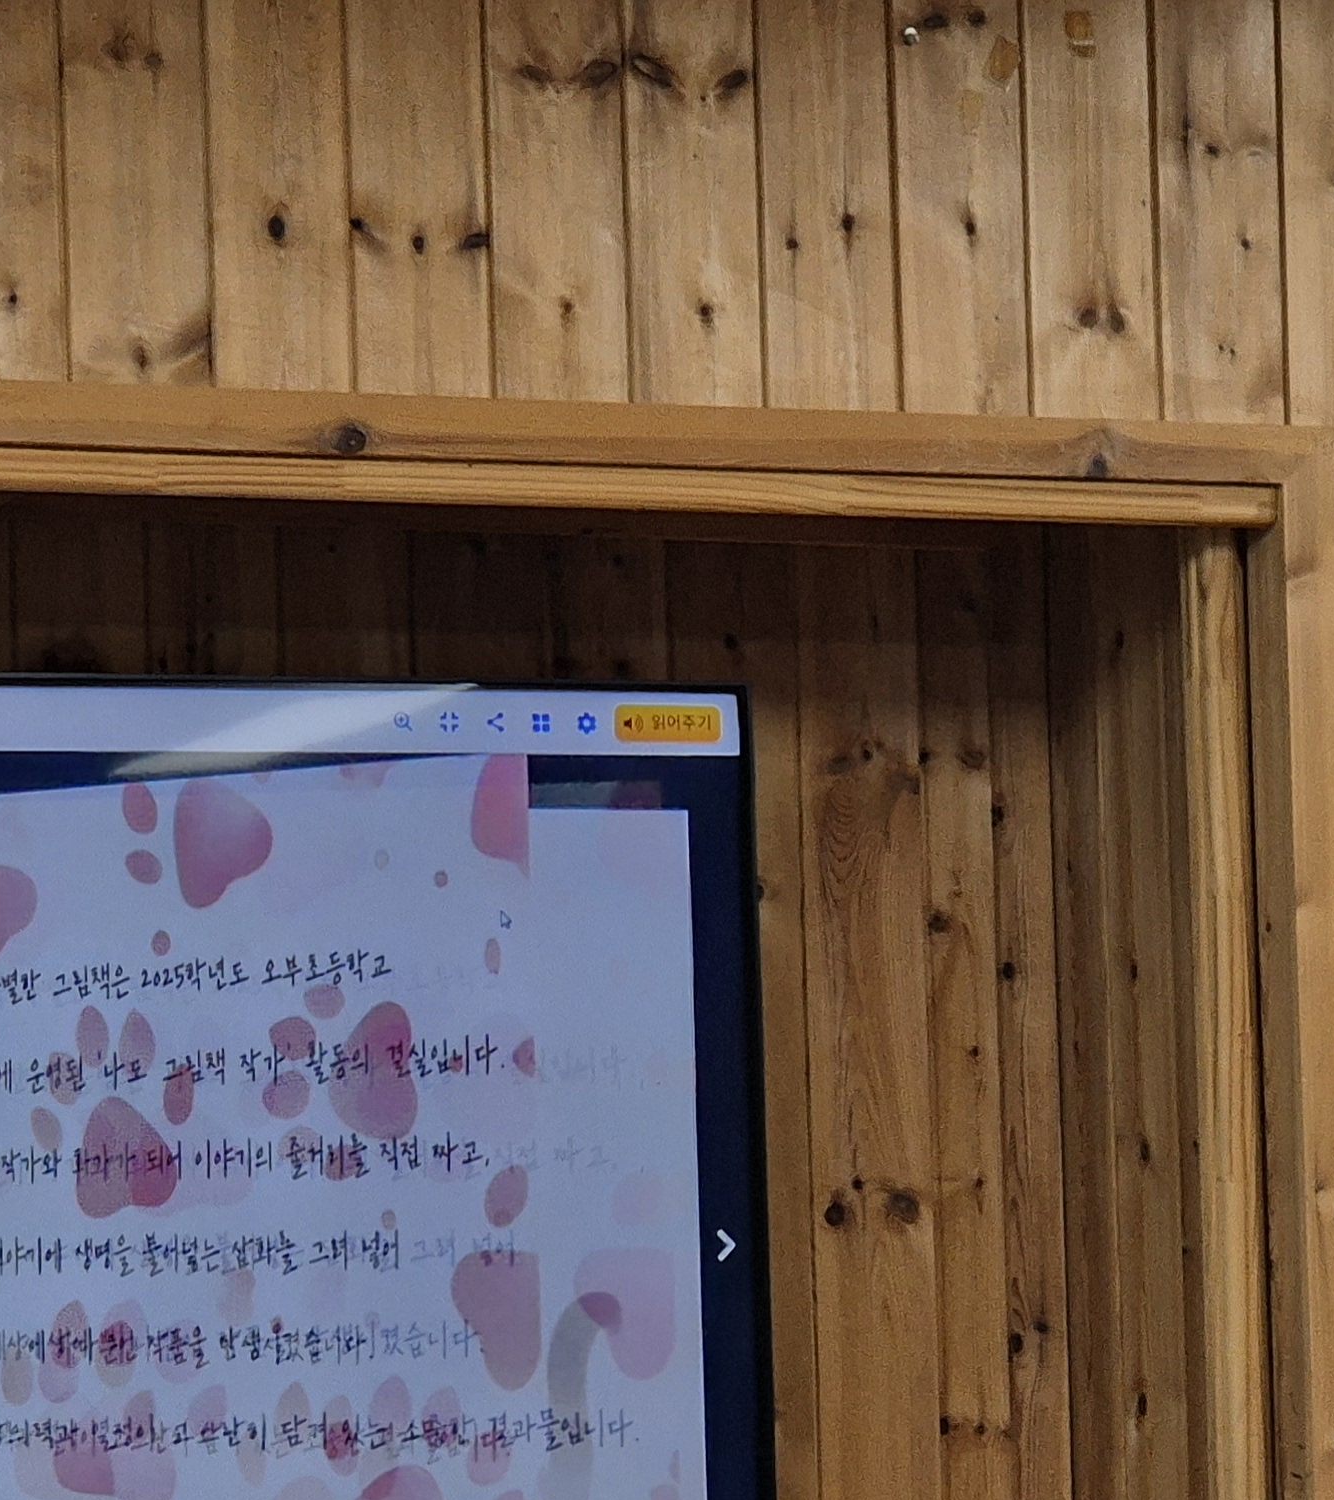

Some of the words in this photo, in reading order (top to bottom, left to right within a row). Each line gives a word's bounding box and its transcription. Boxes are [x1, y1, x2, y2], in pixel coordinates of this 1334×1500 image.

[652, 714, 711, 731] 읽어주기
[53, 960, 132, 1002] 그림책은
[140, 953, 250, 994] 2025학년도
[260, 948, 394, 988] 오부초등학교
[26, 1057, 87, 1095] 운영된
[162, 1044, 226, 1087] 그림책
[306, 1041, 370, 1086] 활동의
[386, 1034, 506, 1080] 결실입니다.
[0, 1145, 63, 1185] 작가와
[71, 1140, 136, 1184] 화가가
[144, 1139, 183, 1181] 되어
[194, 1137, 274, 1181] 이야기의
[287, 1132, 371, 1181] 줄거리를
[378, 1136, 423, 1173] 직접
[74, 1234, 135, 1277] 생명을
